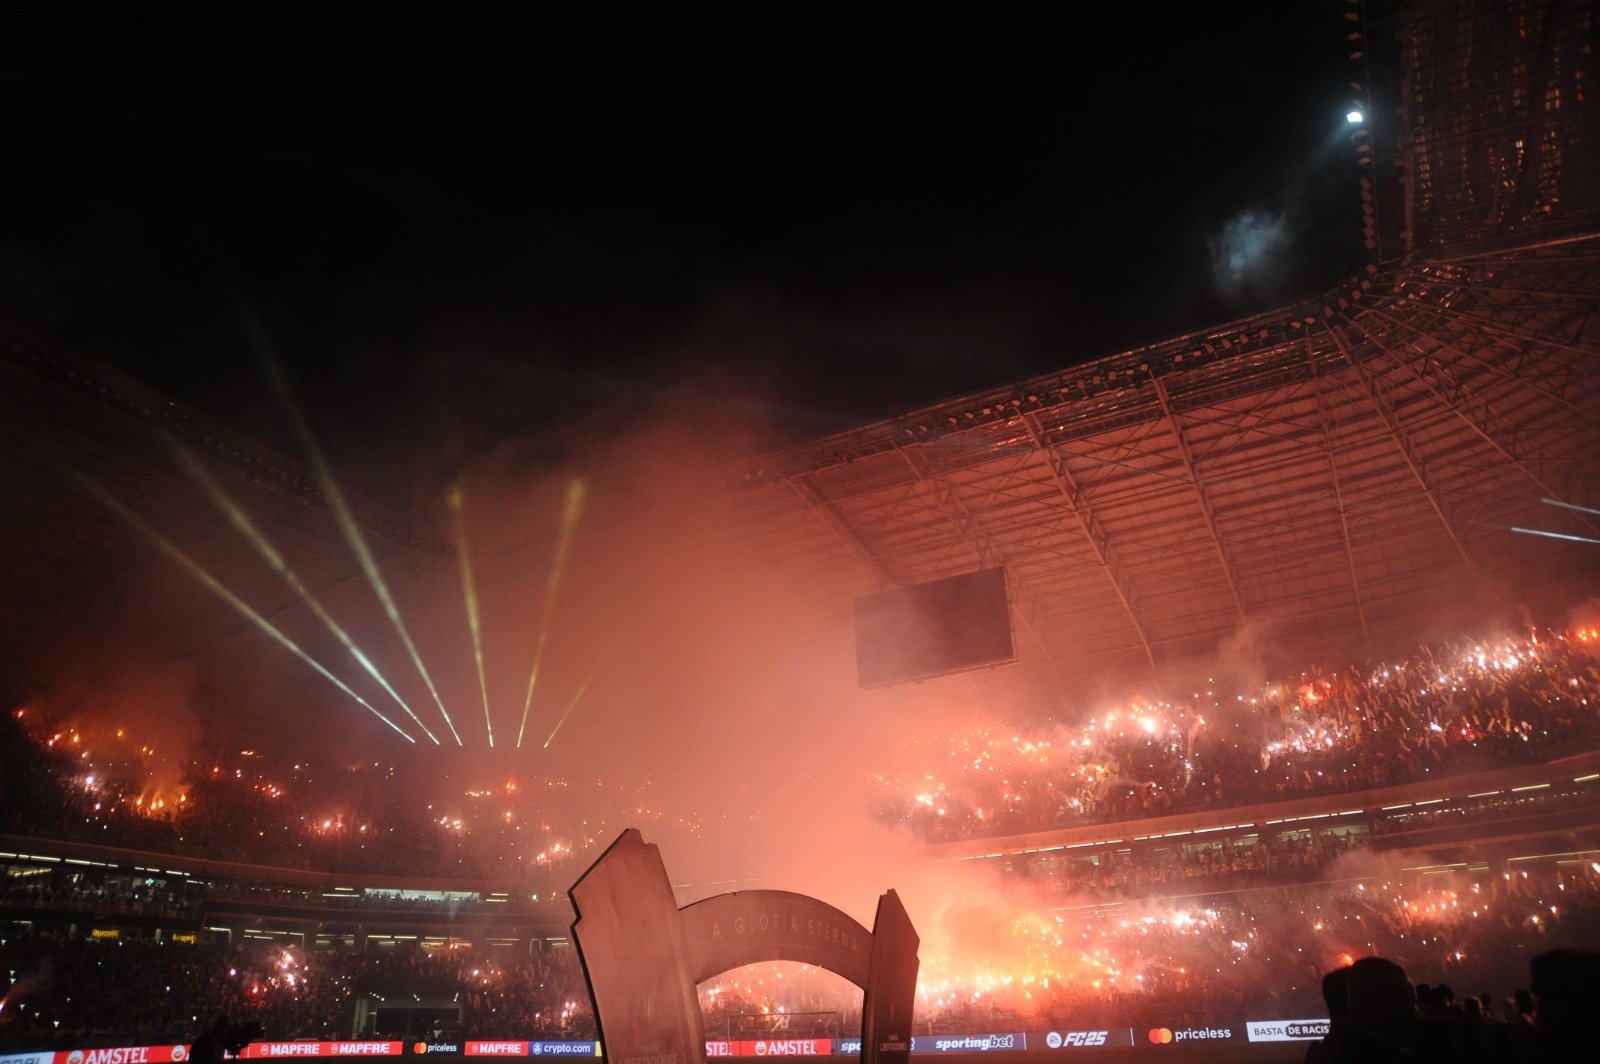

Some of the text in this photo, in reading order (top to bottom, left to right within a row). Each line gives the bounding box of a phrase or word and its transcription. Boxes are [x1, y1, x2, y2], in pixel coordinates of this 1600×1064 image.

[712, 910, 858, 952] A GLÓRIA ETERNA
[1175, 1027, 1232, 1042] priceless
[1254, 1025, 1330, 1036] BASTA DE RACIS
[270, 1043, 320, 1055] MAPFRE
[339, 1043, 391, 1054] MAPFRE
[427, 1043, 457, 1053] priceless
[479, 1043, 522, 1054] MAPFRE
[543, 1043, 591, 1054] crypto.com
[705, 1041, 732, 1056] STEL
[768, 1040, 816, 1055] AMSTEL
[936, 1034, 1014, 1051] sportingbet
[85, 1047, 148, 1064] AMSTEL
